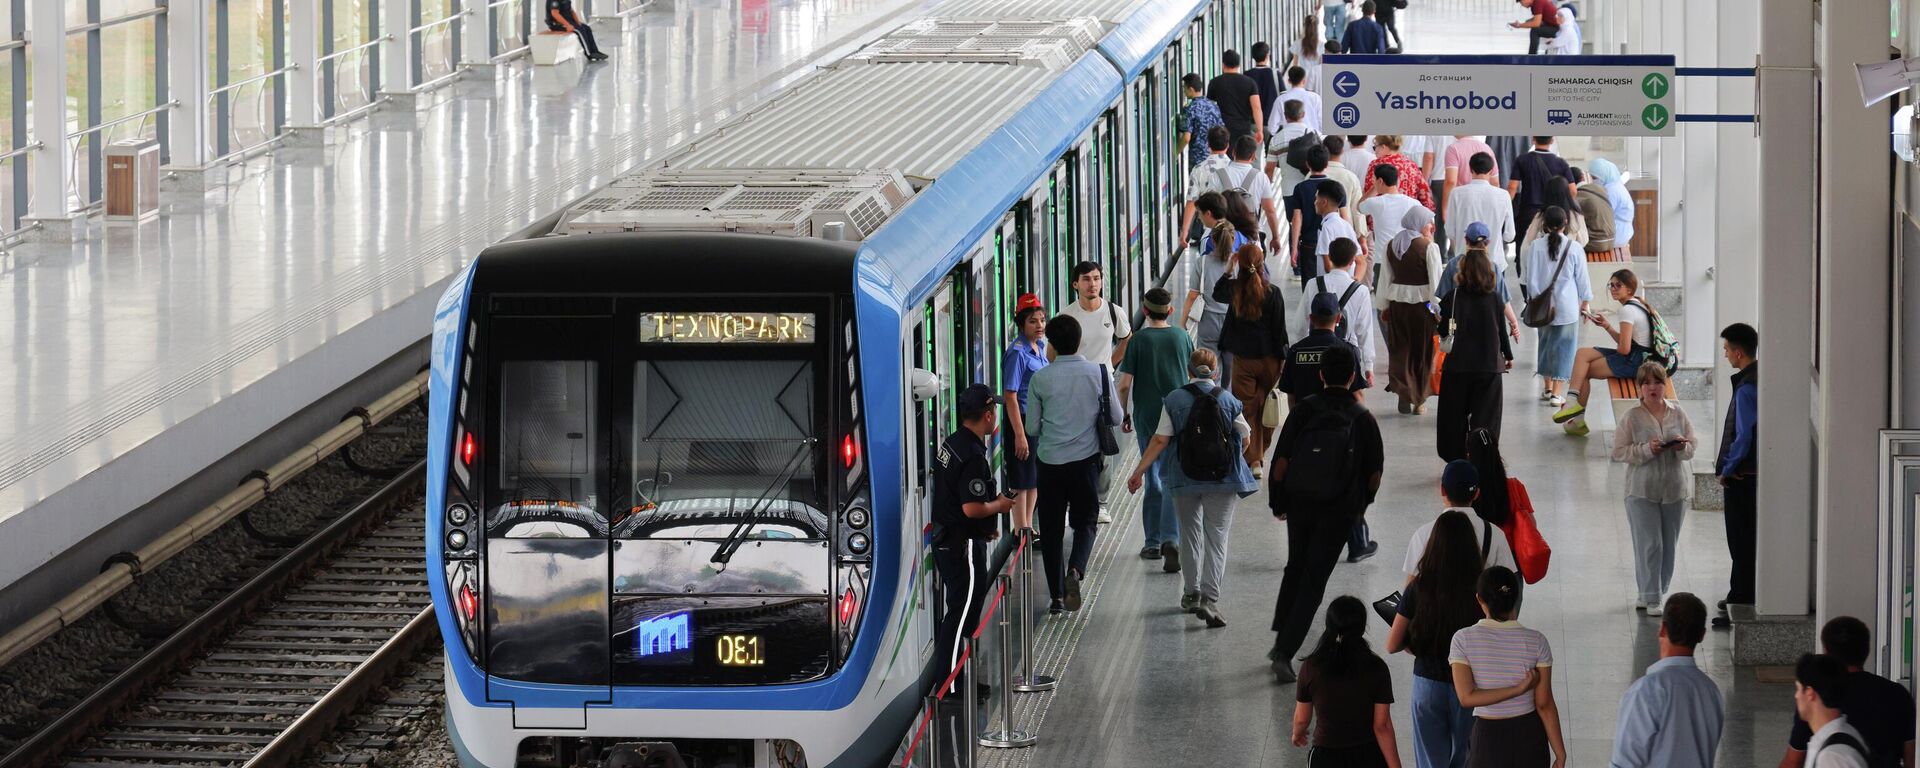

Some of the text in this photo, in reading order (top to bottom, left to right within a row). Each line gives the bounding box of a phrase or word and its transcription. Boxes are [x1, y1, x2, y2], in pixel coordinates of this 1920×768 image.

[1597, 78, 1633, 86] CHIQISH
[1375, 91, 1516, 110] Yashnobod
[1425, 117, 1466, 126] Bekatiga
[654, 315, 807, 339] TEXNOPARK
